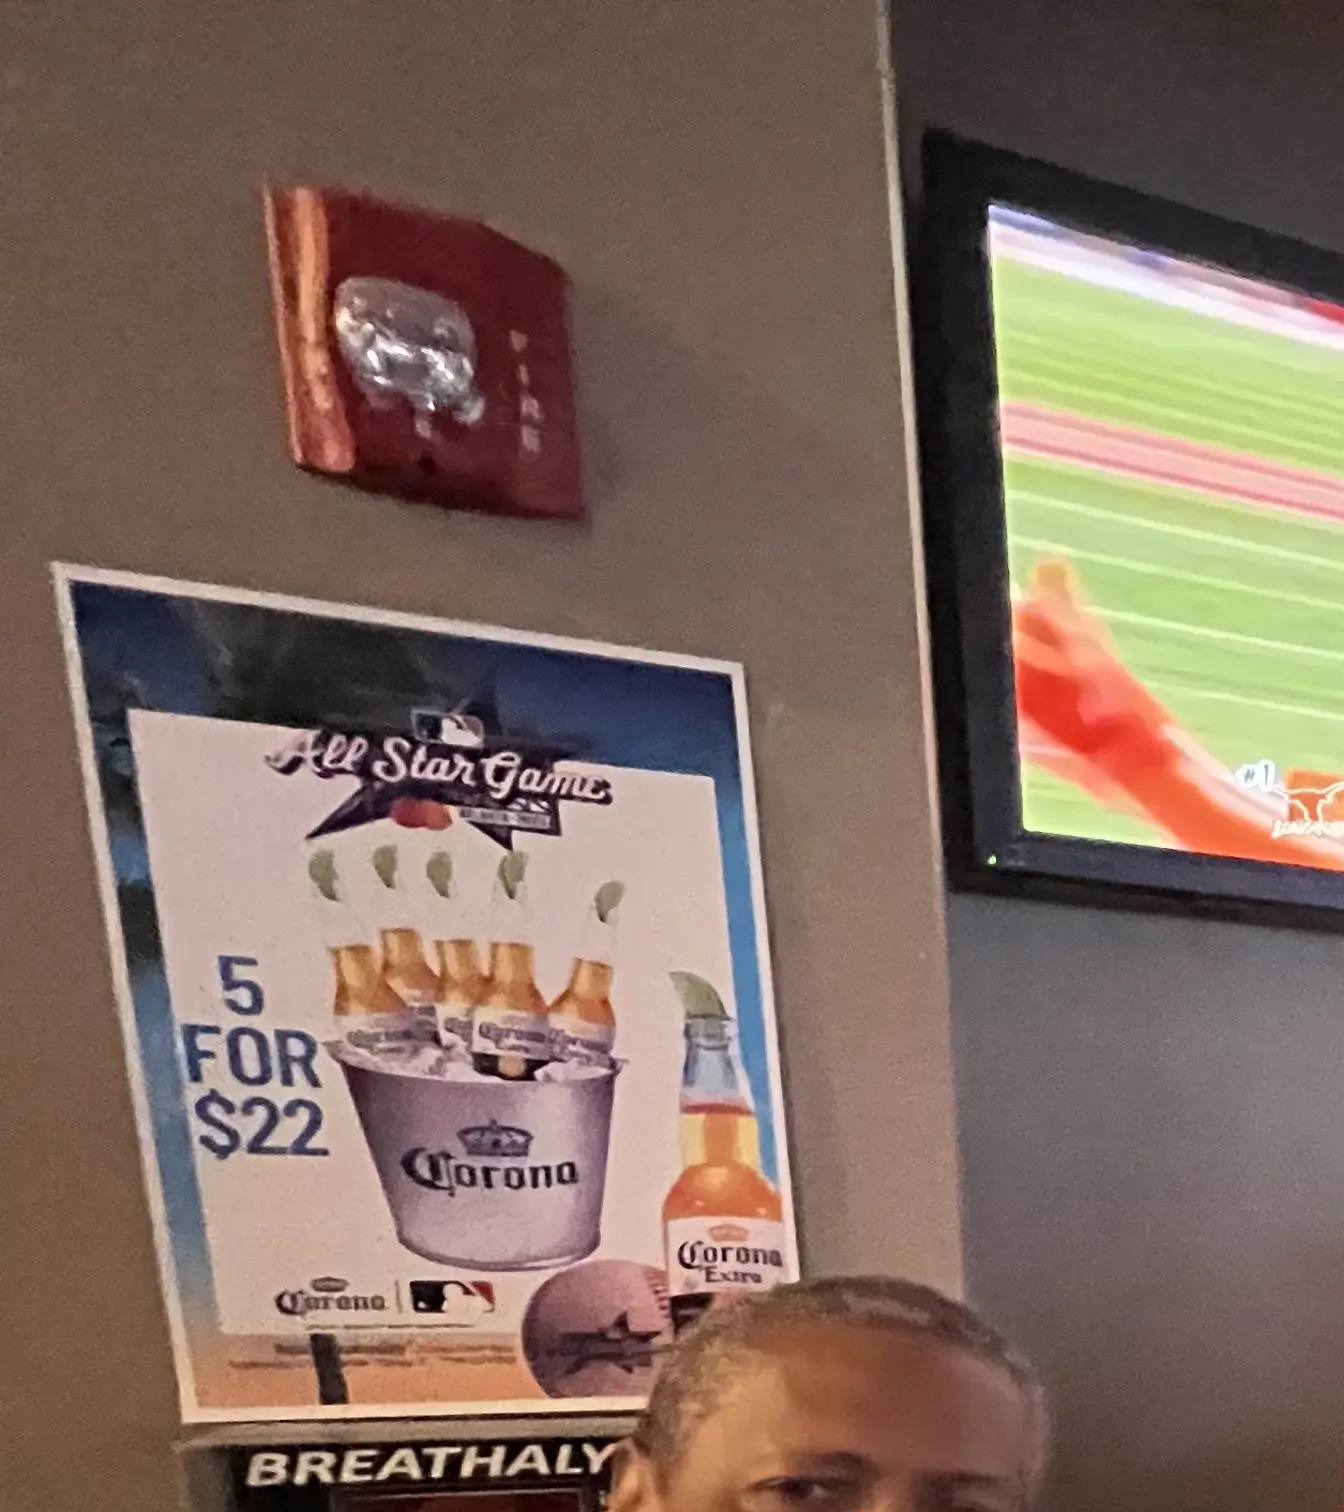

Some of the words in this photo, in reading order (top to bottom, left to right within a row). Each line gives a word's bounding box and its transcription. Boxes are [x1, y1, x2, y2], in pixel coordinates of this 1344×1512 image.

[264, 728, 369, 777] All
[373, 736, 475, 787] Star
[481, 752, 612, 801] Game
[216, 955, 265, 1016] 5
[181, 1025, 323, 1090] FOR
[198, 1096, 330, 1160] $22
[401, 1149, 580, 1196] Corona
[677, 1239, 784, 1270] Corona
[703, 1265, 762, 1284] Extra
[275, 1288, 387, 1317] Corona
[246, 1443, 620, 1487] BREATHALY
